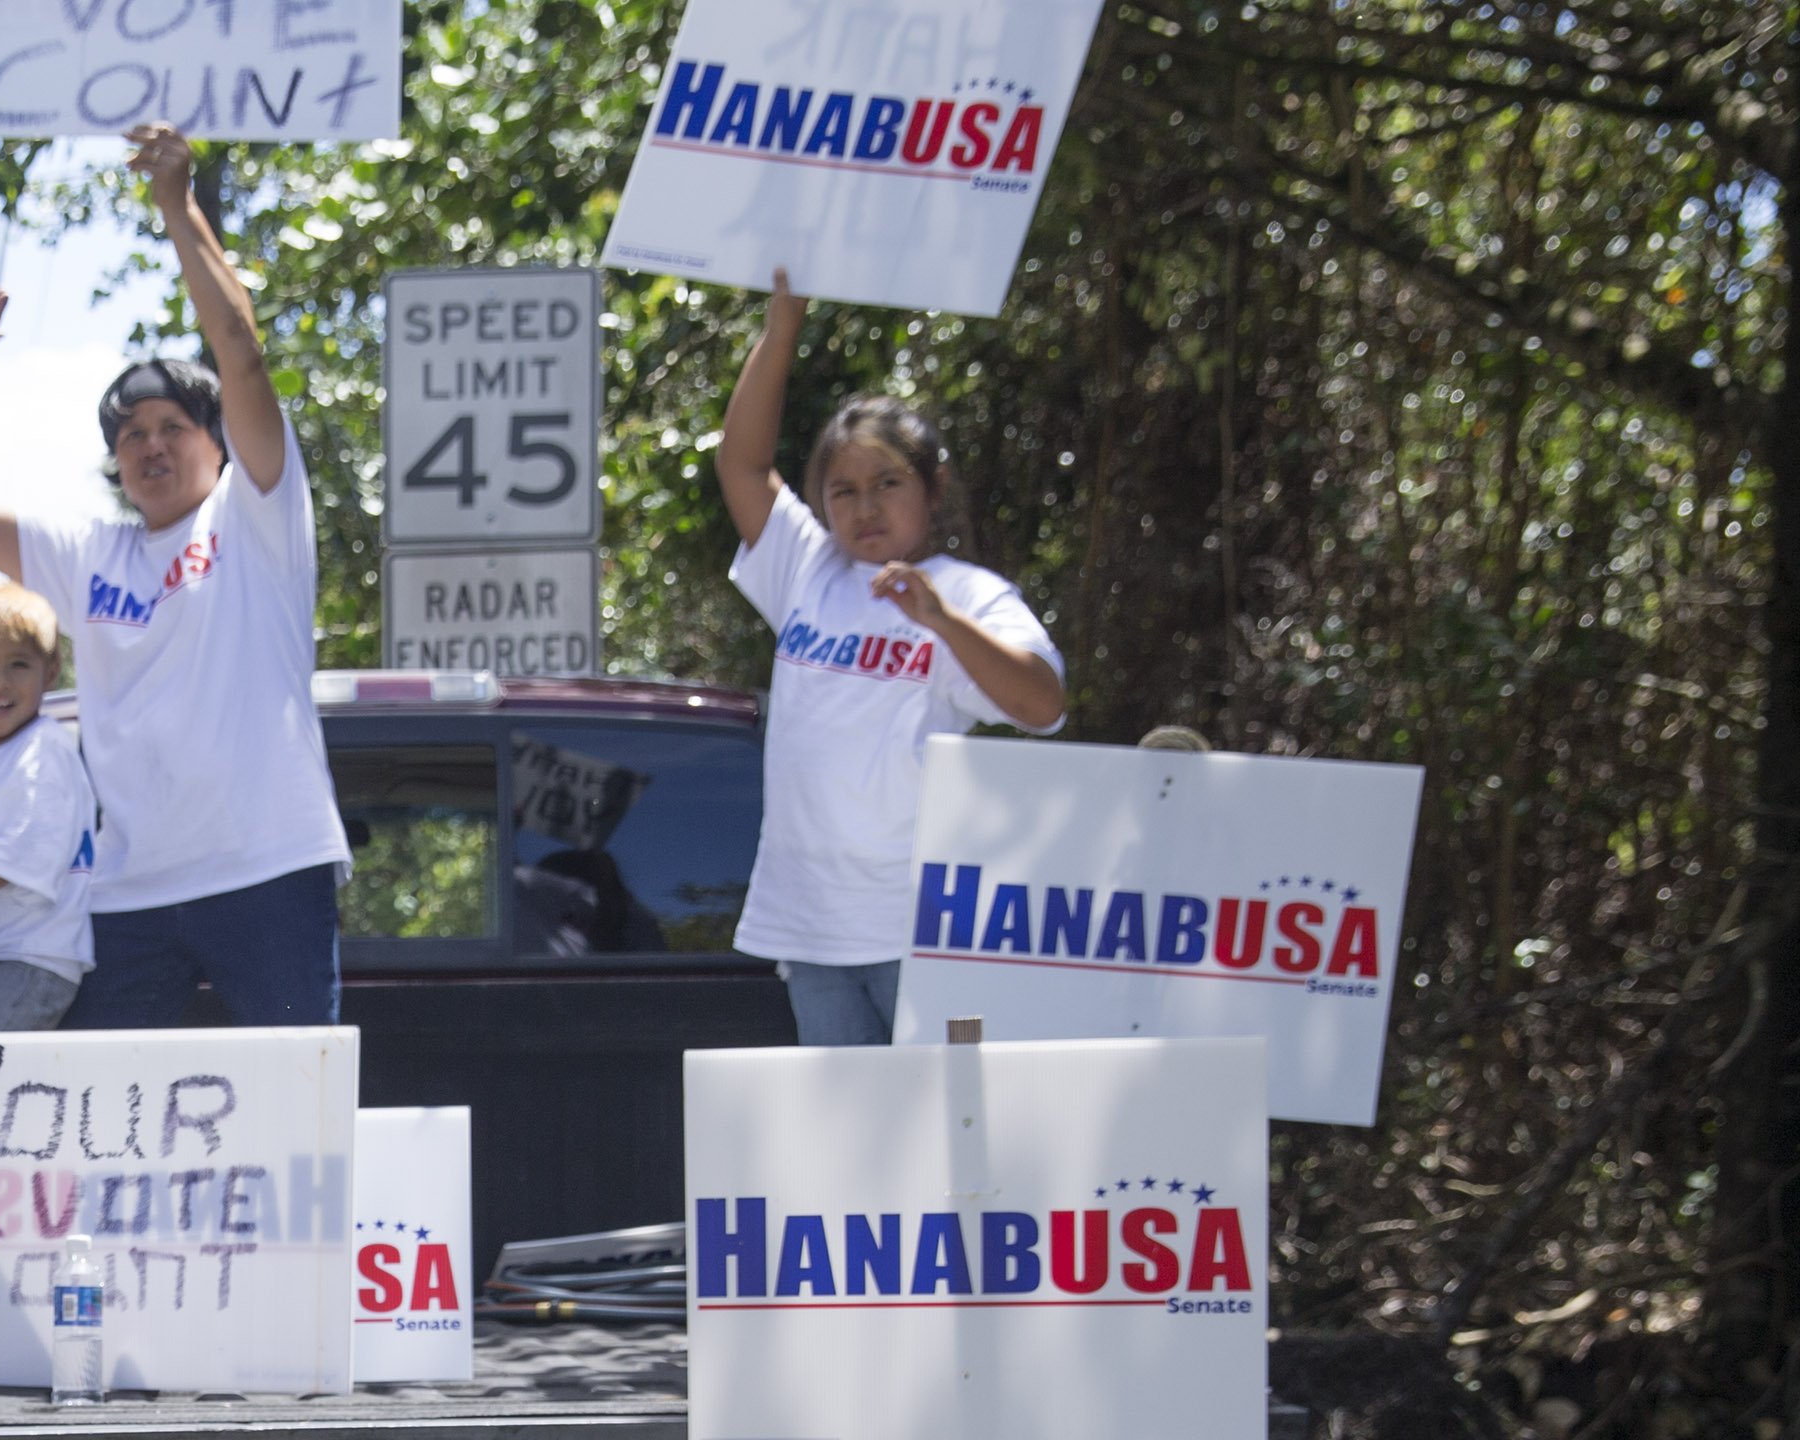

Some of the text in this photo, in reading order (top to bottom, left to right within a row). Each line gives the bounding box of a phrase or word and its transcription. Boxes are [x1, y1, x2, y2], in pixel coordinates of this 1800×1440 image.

[655, 60, 1045, 173] HANABUSA
[404, 303, 580, 343] SPEED
[422, 357, 557, 399] LIMIT
[403, 413, 576, 508] 45
[424, 580, 557, 622] RADAR
[396, 635, 588, 676] ENFORCED
[911, 863, 1379, 977] HANABUSA
[32, 1165, 266, 1238] VOTE
[697, 1197, 1252, 1297] HANABUSA
[357, 1243, 459, 1313] SA
[1167, 1297, 1252, 1314] Senate
[395, 1317, 461, 1331] Senate
